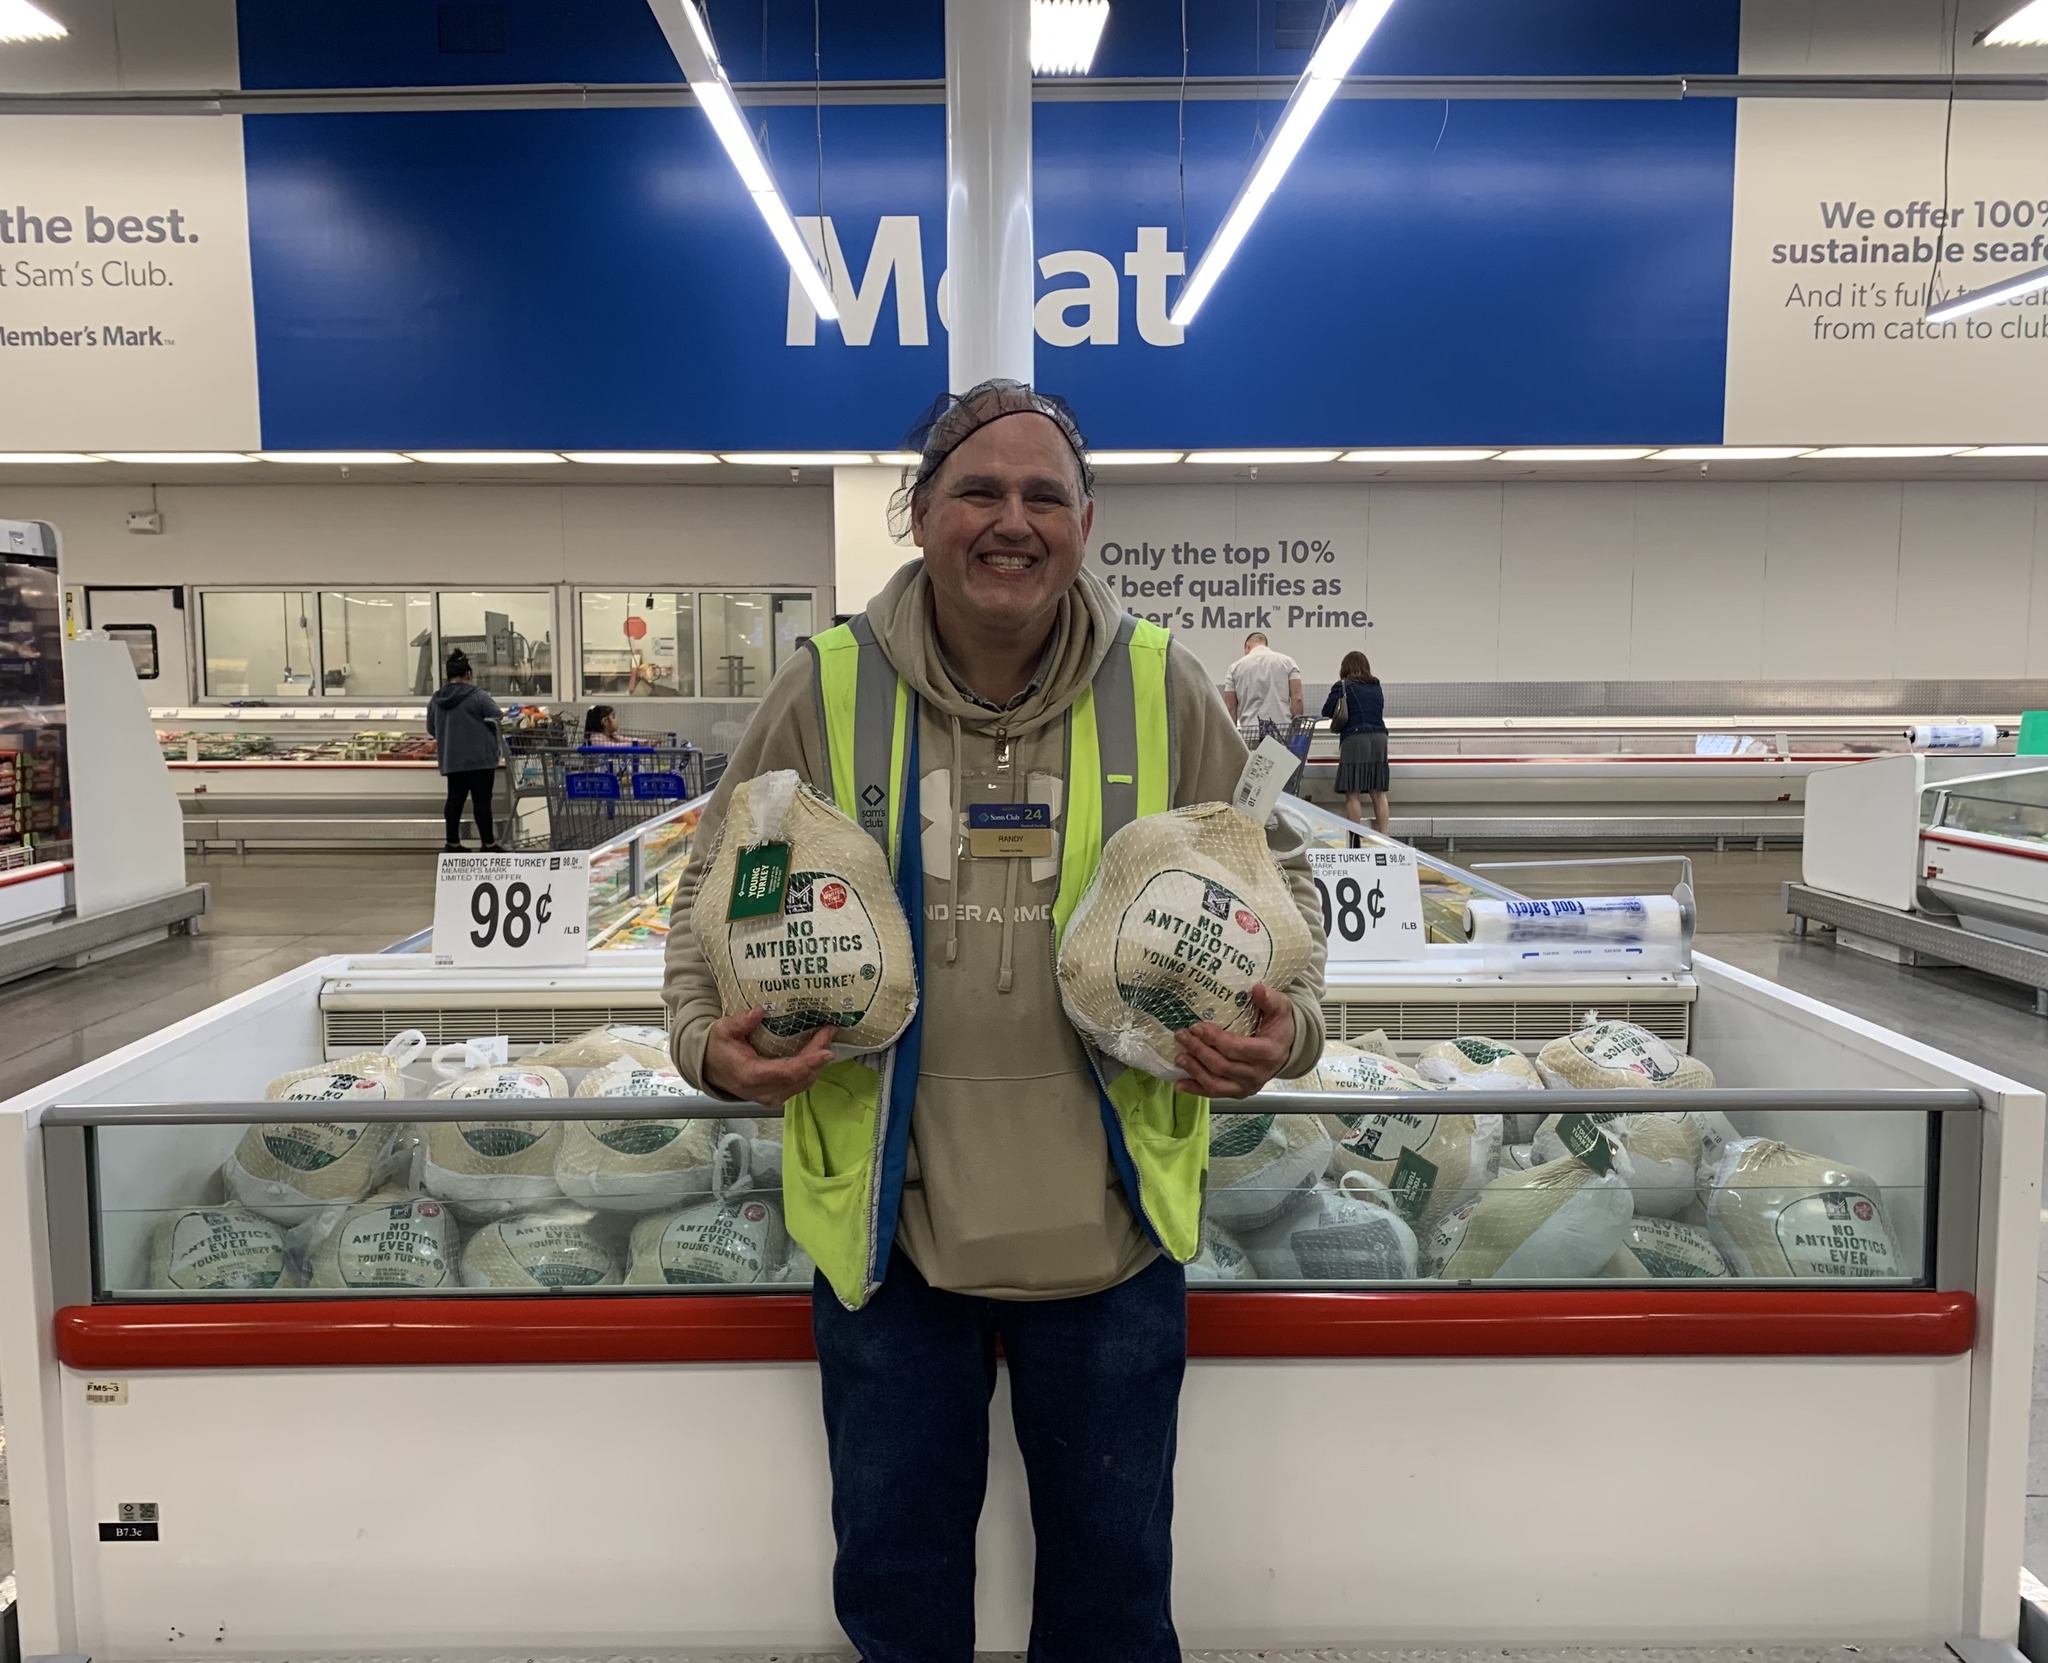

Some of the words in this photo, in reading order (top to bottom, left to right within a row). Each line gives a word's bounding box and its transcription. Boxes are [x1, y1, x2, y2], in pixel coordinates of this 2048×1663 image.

[0, 206, 72, 243] the
[85, 206, 199, 243] best.
[1820, 201, 1875, 229] We
[1884, 201, 1964, 228] offer
[1771, 235, 1963, 264] sustainable
[15, 261, 94, 287] Sam's
[101, 261, 173, 287] Club.
[786, 215, 1185, 348] Mat
[1785, 283, 1842, 307] And
[1852, 283, 1886, 307] it's
[1814, 315, 1875, 340] from
[1966, 317, 1992, 339] to
[1100, 542, 1165, 570] Only
[1172, 542, 1216, 565] the
[1223, 543, 1270, 569] top
[1278, 540, 1335, 564] 10%
[1121, 574, 1183, 597] beef
[1189, 573, 1305, 602] qualifies
[1312, 577, 1341, 596] as
[1127, 606, 1194, 629] ber's
[1288, 605, 1374, 629] Prime.
[861, 808, 886, 818] sam's
[1024, 808, 1043, 821] 24
[865, 818, 884, 828] club
[998, 835, 1024, 843] RANDY
[441, 858, 489, 868] ANTIBIOTIC
[490, 857, 512, 867] FREE
[514, 857, 547, 867] TURKEY
[1315, 853, 1337, 863] FREE
[1338, 853, 1371, 863] TURKEY
[748, 867, 760, 898] YOUNG
[756, 864, 769, 899] TURKEY
[924, 904, 981, 921] NDER
[1505, 900, 1551, 917] Safety
[1554, 900, 1585, 915] Food
[563, 926, 580, 935] /LB
[787, 920, 814, 938] NO
[1198, 914, 1224, 938] NO
[1401, 922, 1417, 930] /LB
[745, 934, 863, 960] ANTIBIOTICS
[1143, 908, 1256, 977] ANTIBIOTICS
[780, 956, 830, 976] EVER
[1173, 939, 1223, 976] EVER
[758, 976, 801, 992] YOUNG
[804, 974, 856, 989] TURKEY
[1142, 947, 1187, 974] YOUNG
[1188, 966, 1234, 1002] TURKEY
[389, 1222, 410, 1231] NO
[1832, 1224, 1855, 1237] NO
[352, 1231, 439, 1250] ANTIBIOTICS
[378, 1241, 415, 1253] EVER
[676, 1224, 757, 1251] ANTIBIOTICS
[1795, 1234, 1888, 1256] ANTIBIOTICS
[358, 1253, 391, 1263] YOUNG
[677, 1241, 709, 1252] YOUNG
[712, 1244, 748, 1266] TURKEY
[1830, 1249, 1868, 1266] EVER
[1810, 1261, 1846, 1275] YOUNG
[116, 1527, 143, 1537] B7.3c
